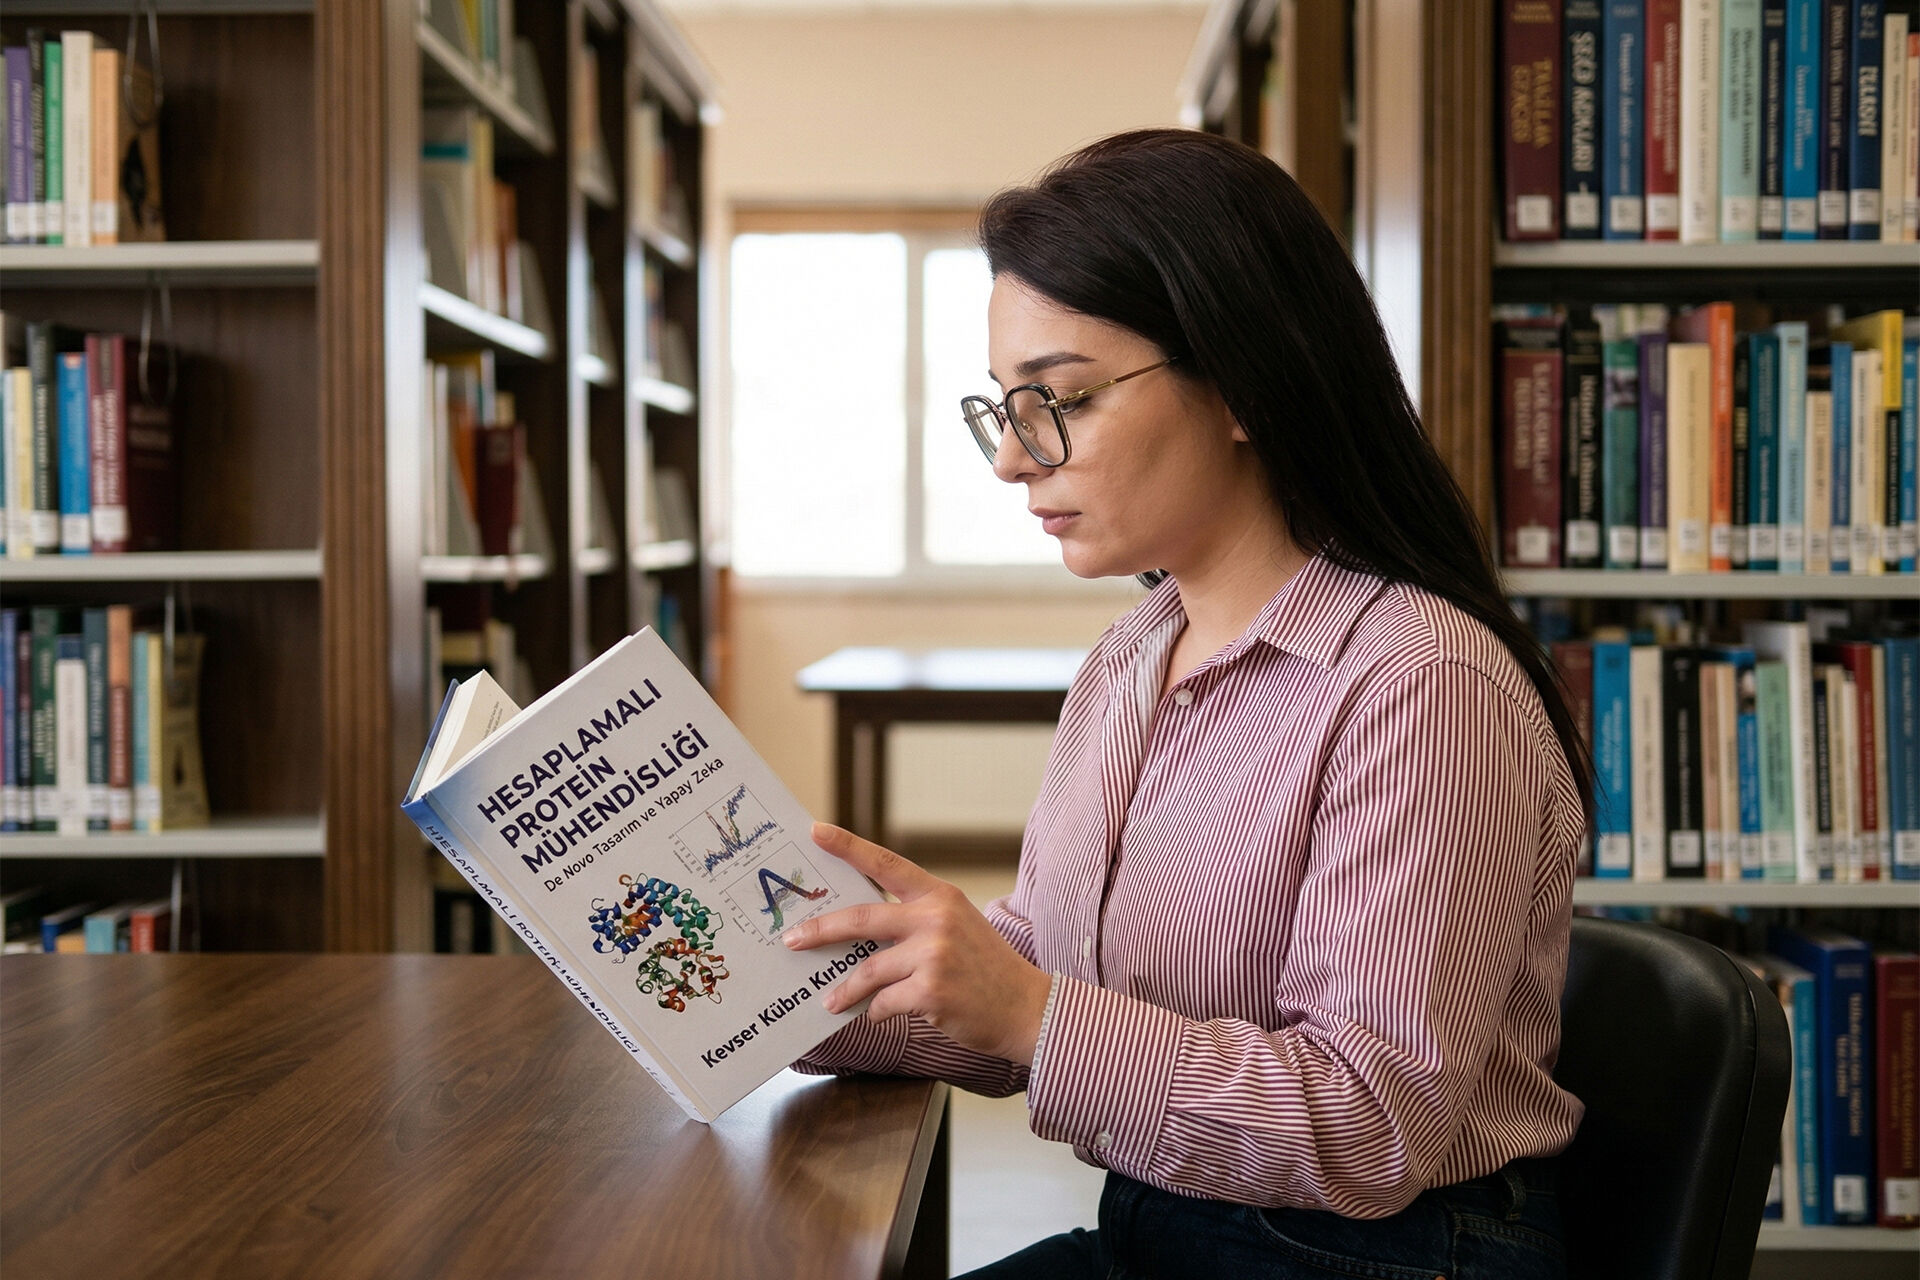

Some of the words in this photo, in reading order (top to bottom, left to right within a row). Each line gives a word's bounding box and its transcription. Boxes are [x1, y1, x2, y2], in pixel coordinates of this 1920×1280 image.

[477, 678, 662, 824] HESAPLAMALI
[500, 755, 616, 849] PROTEİN
[521, 723, 709, 874] MÜHENDİSLİĞİ
[544, 873, 564, 892] De
[562, 852, 594, 880] Novo
[593, 820, 642, 856] Tasarım
[640, 808, 657, 822] ve
[655, 780, 693, 810] Yapay
[692, 757, 724, 785] Zeka
[701, 1022, 760, 1068] Kevser
[757, 987, 812, 1027] Kübra
[809, 939, 879, 990] Kırboğa
